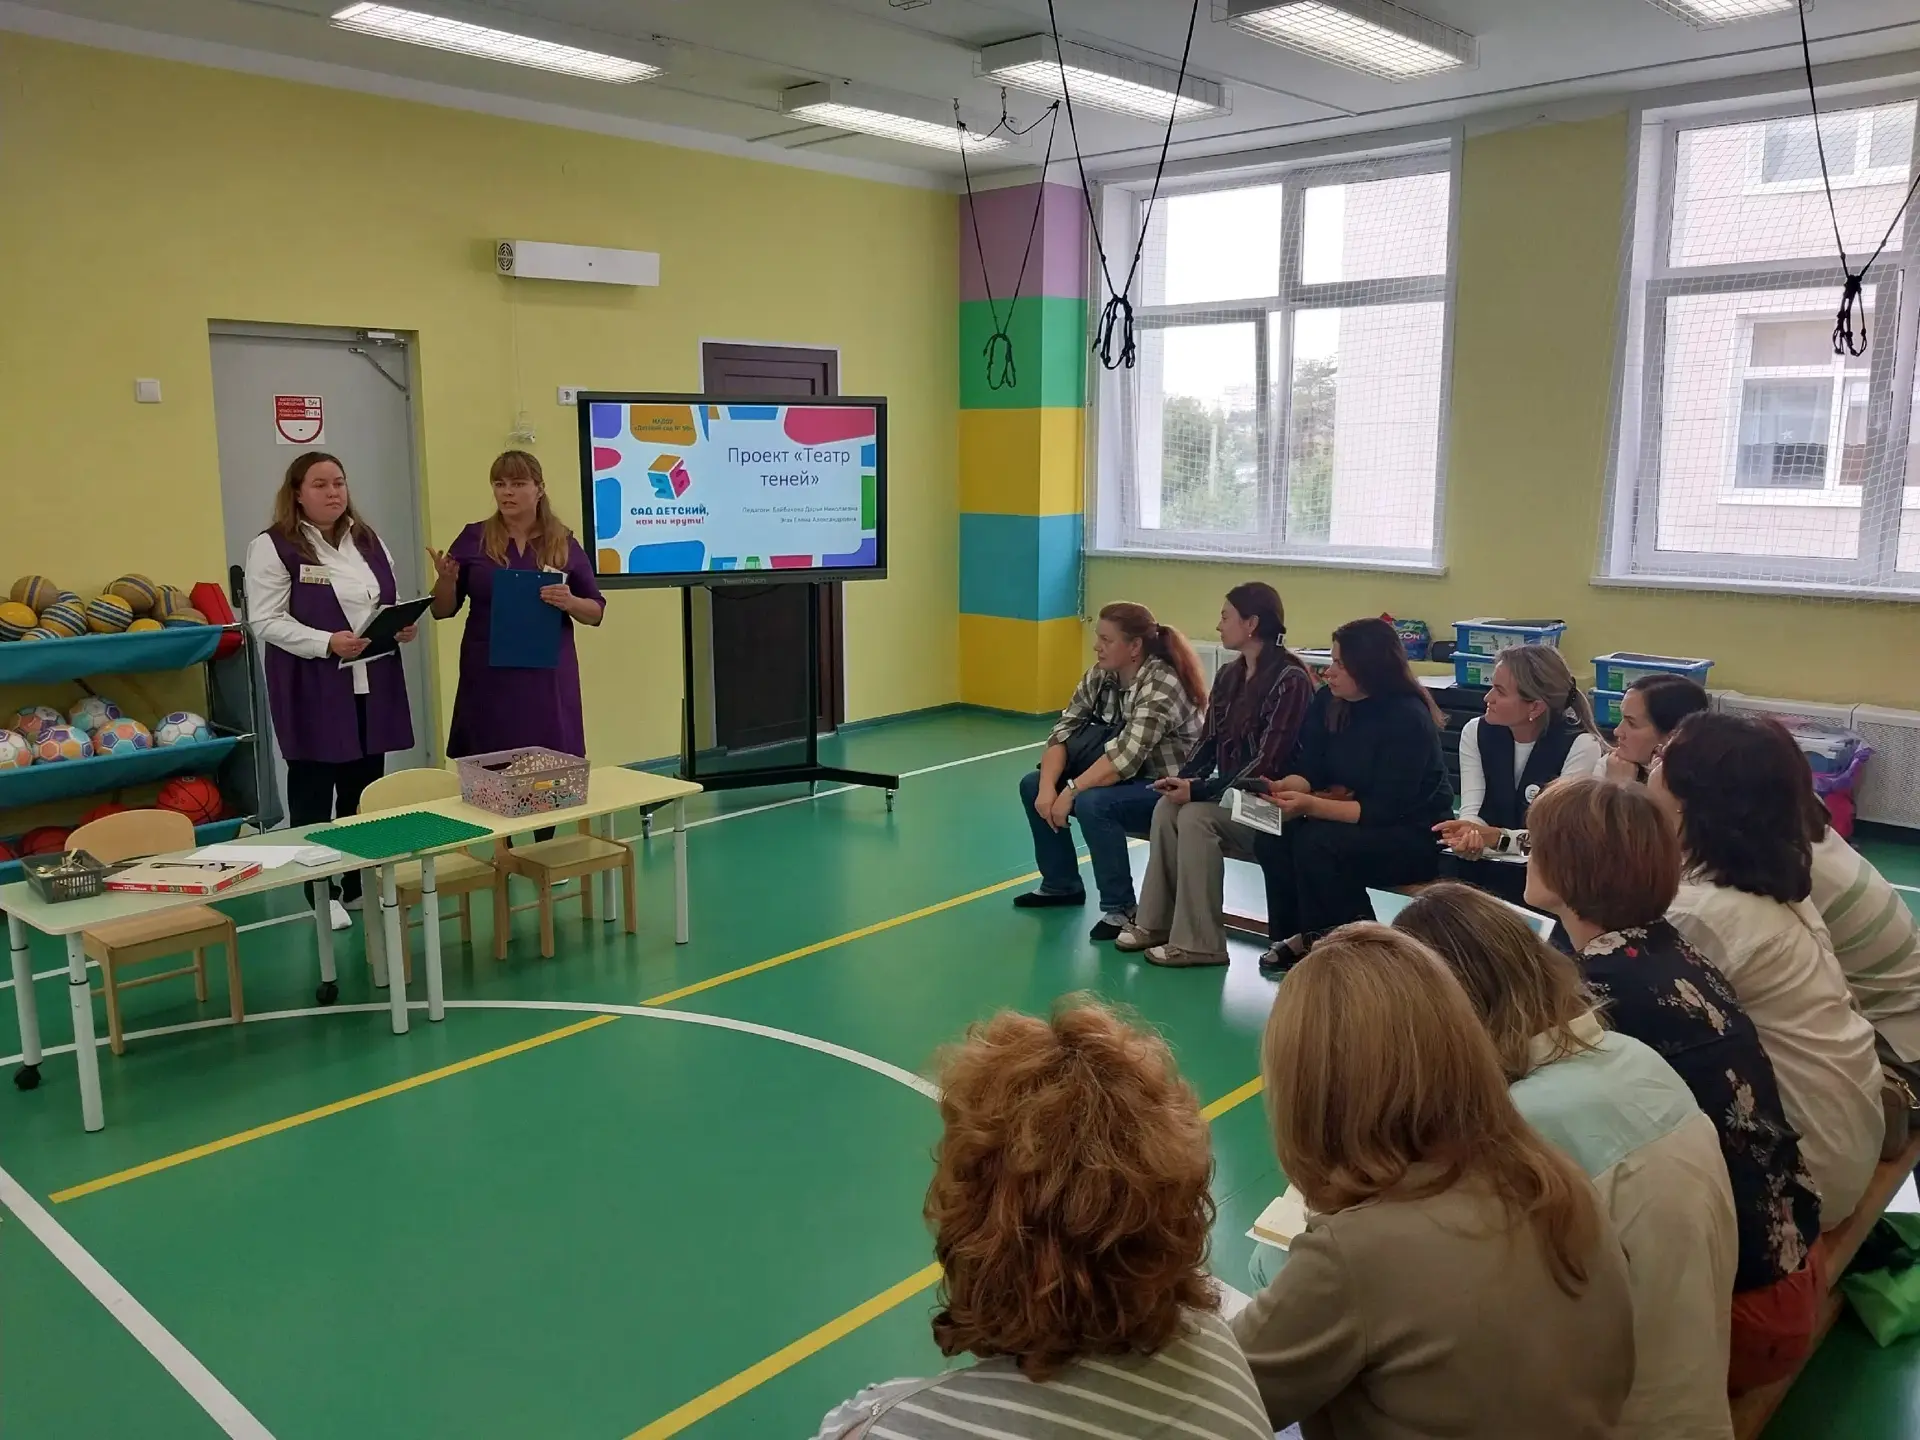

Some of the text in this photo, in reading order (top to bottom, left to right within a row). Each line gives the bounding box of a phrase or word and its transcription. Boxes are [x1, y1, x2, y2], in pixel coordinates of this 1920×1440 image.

[728, 447, 851, 466] Проект «Театр
[760, 470, 819, 487] теней»
[630, 503, 710, 516] САД ДЕТСКИЙ,
[670, 517, 705, 526] крути!
